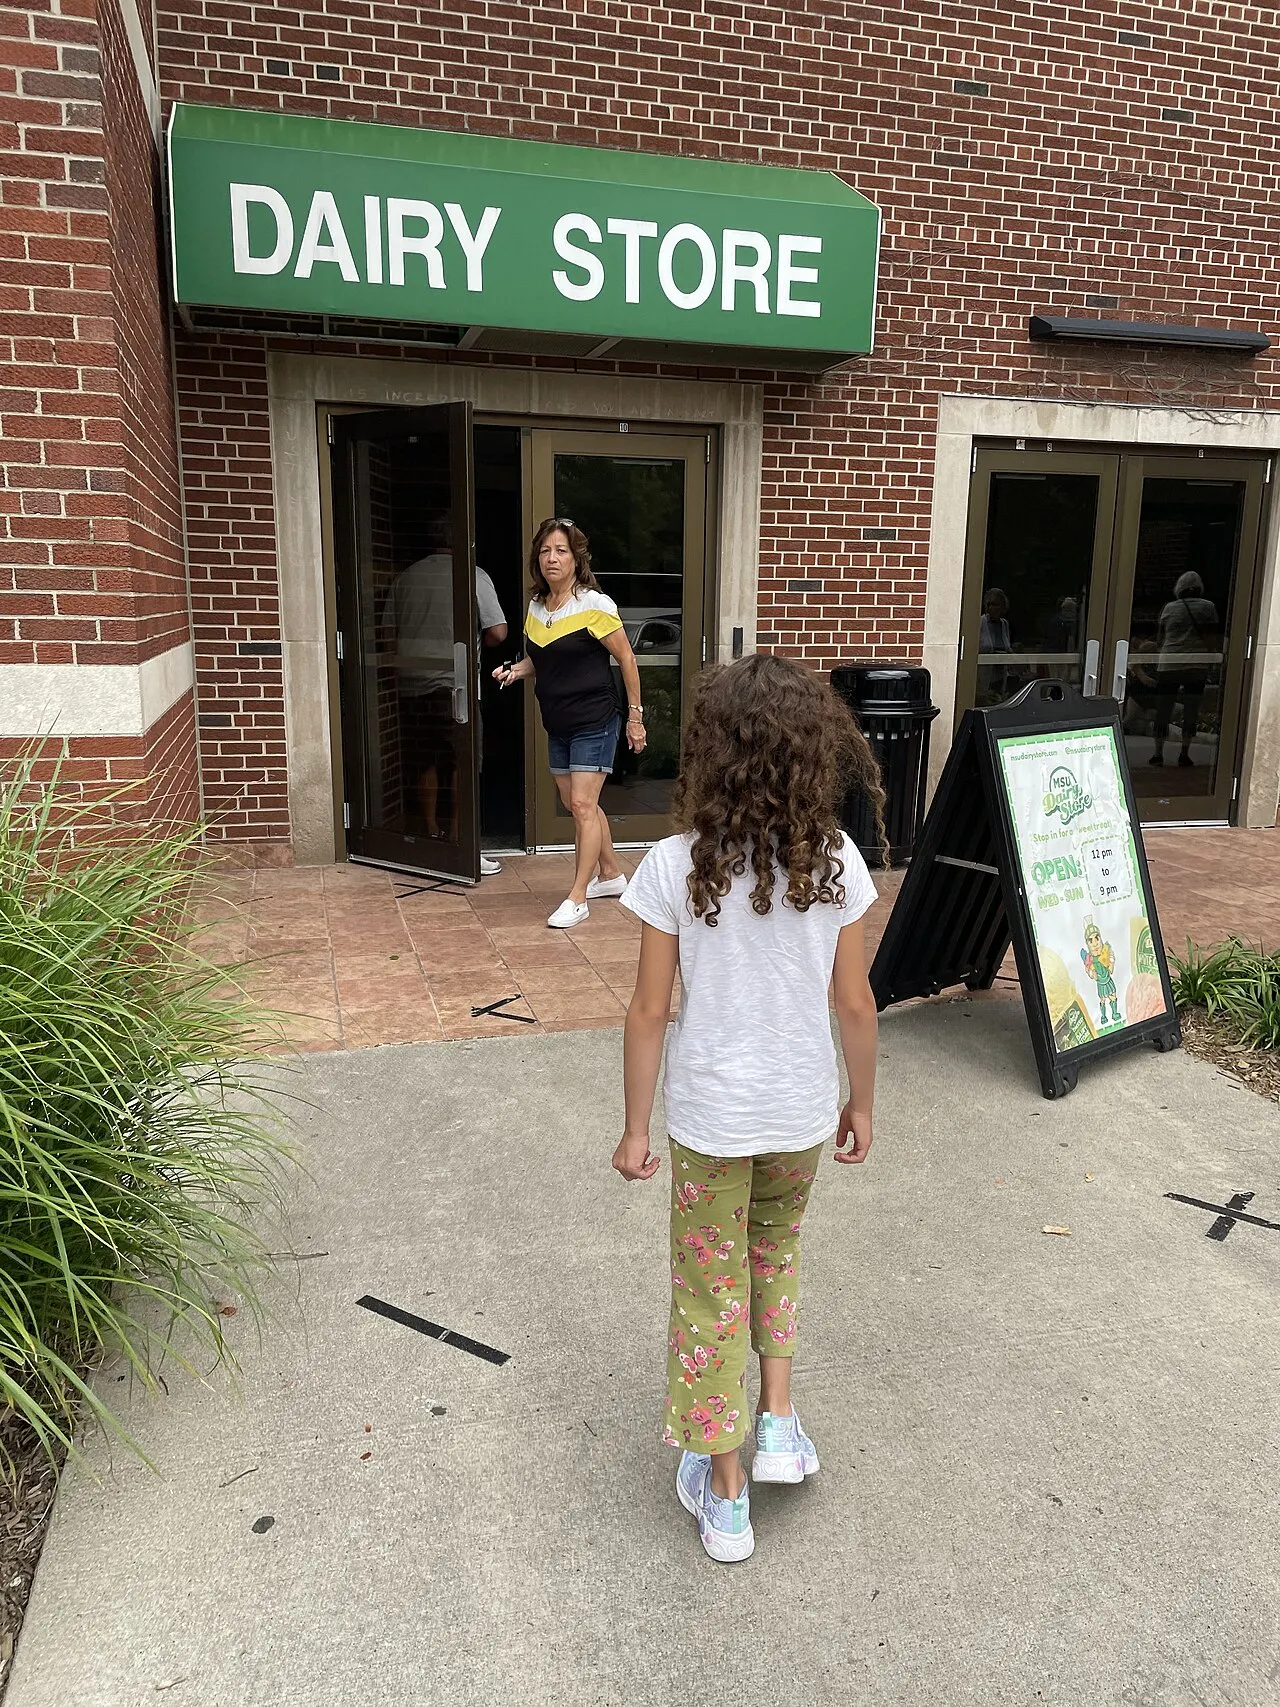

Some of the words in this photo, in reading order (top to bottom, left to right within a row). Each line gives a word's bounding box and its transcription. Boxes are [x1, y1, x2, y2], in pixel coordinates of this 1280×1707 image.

[229, 182, 501, 292] DAIRY
[552, 212, 822, 318] STORE
[1053, 776, 1071, 789] MSU
[1042, 784, 1079, 811] Dairy
[1060, 794, 1089, 821] Store
[1033, 833, 1049, 843] Stop
[1050, 830, 1058, 839] in
[1059, 828, 1068, 838] for
[1091, 849, 1100, 859] 12
[1102, 848, 1113, 860] pm
[1031, 854, 1082, 885] OPEN:
[1101, 868, 1109, 876] to
[1037, 893, 1060, 909] WED
[1064, 886, 1084, 902] SUN
[1100, 886, 1105, 895] 9
[1106, 885, 1118, 896] pm
